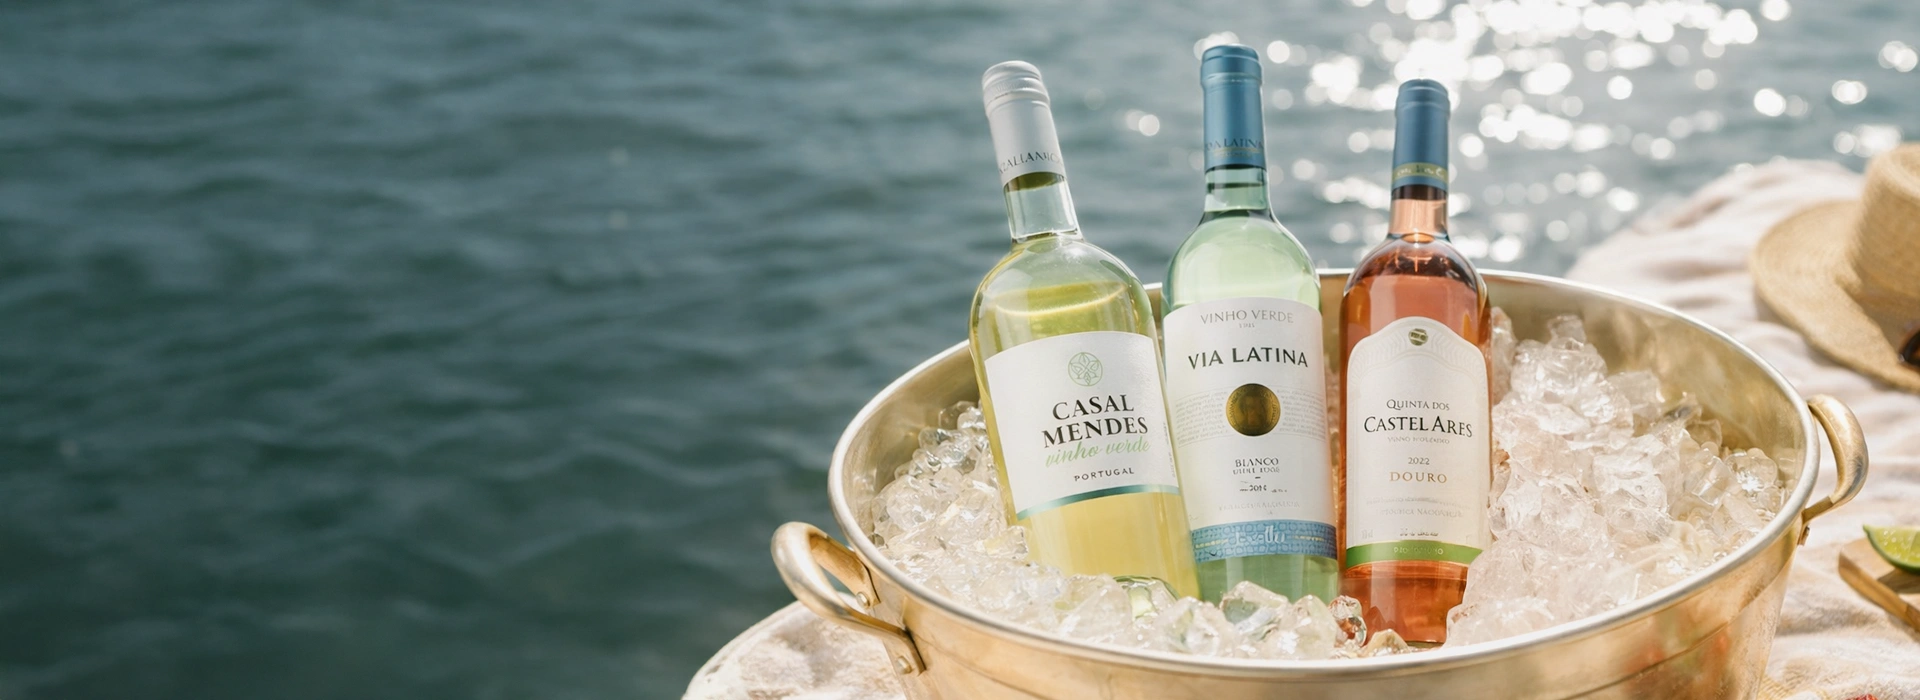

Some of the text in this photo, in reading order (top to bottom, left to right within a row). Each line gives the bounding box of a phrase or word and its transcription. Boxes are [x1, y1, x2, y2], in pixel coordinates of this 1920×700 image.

[1200, 309, 1294, 324] VINHO VERDE
[1188, 347, 1308, 370] VIA LATINA
[1052, 394, 1134, 420] CASAL
[1386, 399, 1450, 411] QUINTA DOS
[1041, 417, 1148, 448] MENDES
[1045, 441, 1100, 468] vinho
[1105, 436, 1150, 455] verde
[1408, 457, 1430, 465] 2022
[1074, 467, 1135, 482] PORTUGAL
[1389, 471, 1448, 483] DOURO
